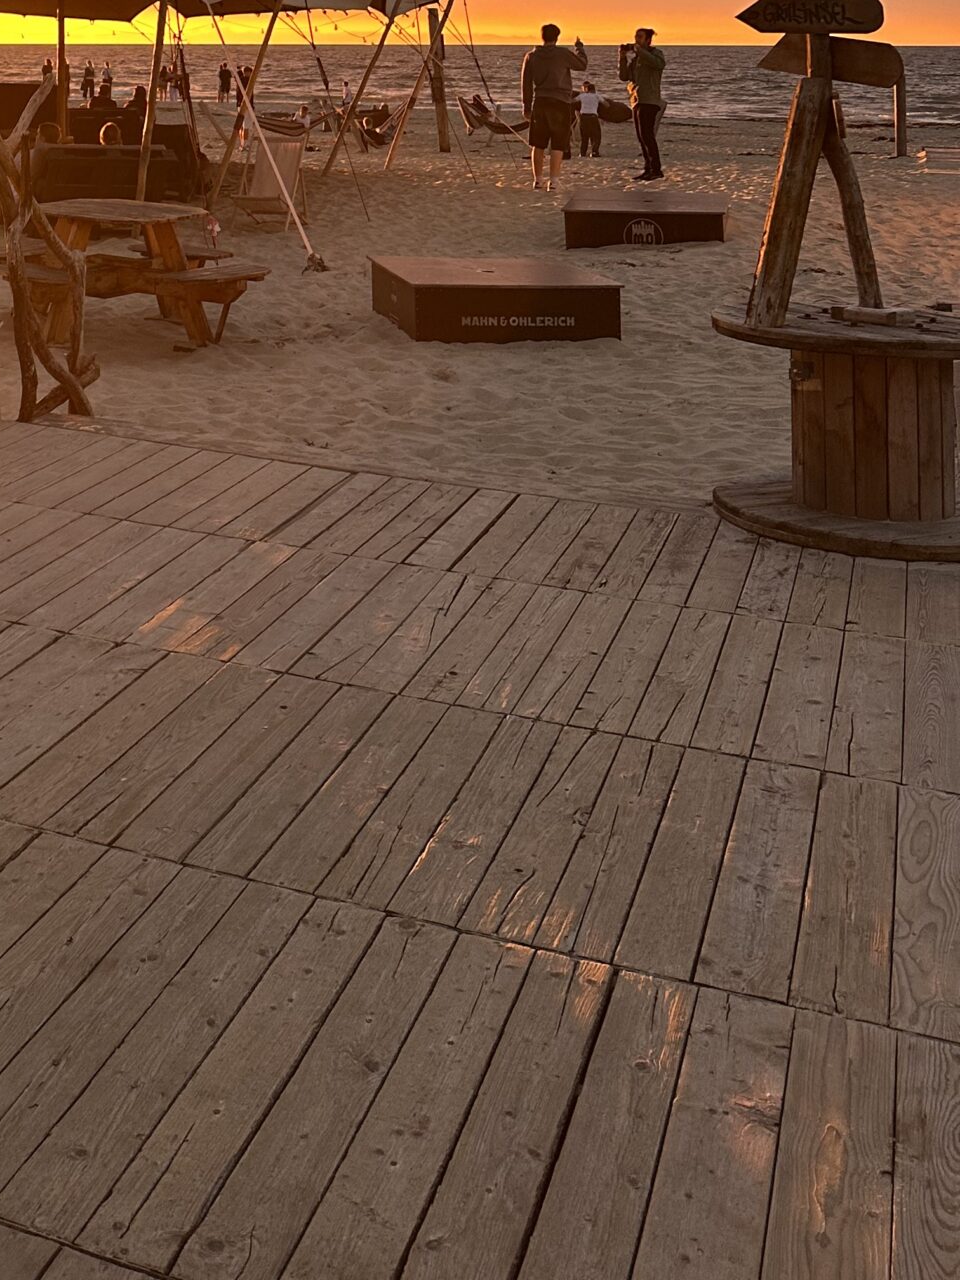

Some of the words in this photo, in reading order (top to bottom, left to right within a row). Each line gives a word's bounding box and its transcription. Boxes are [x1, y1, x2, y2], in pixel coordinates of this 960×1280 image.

[461, 315, 498, 327] MAHN
[499, 315, 508, 327] &
[509, 315, 576, 327] OHLERICH
